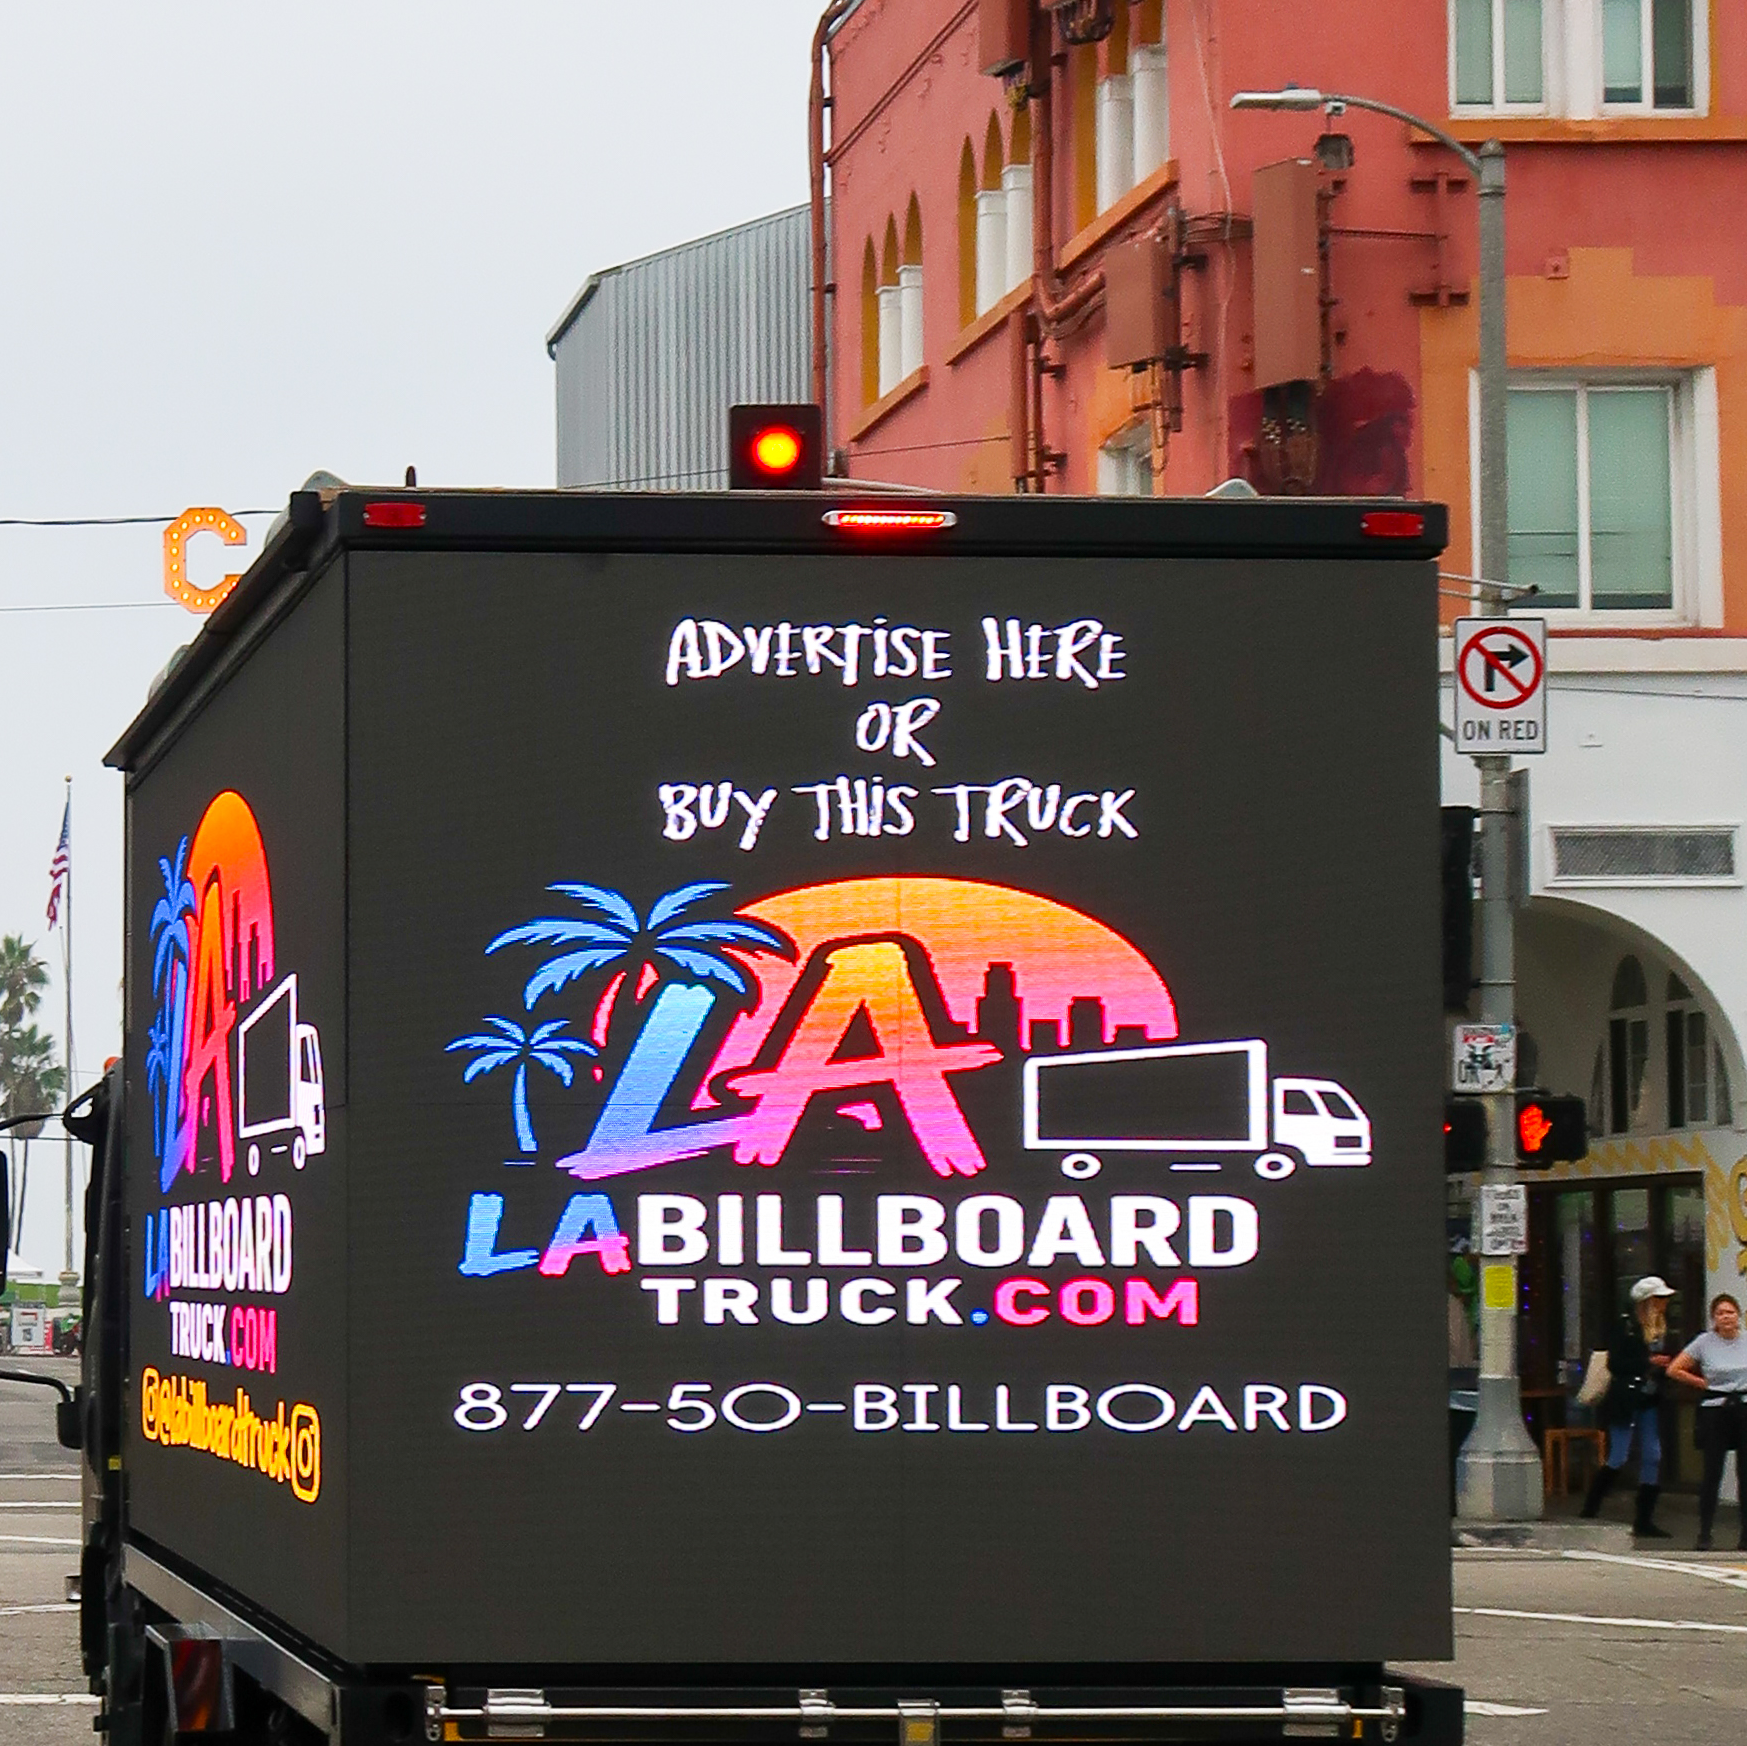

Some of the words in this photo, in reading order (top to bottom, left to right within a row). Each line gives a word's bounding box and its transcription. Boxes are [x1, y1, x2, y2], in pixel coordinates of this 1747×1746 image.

[666, 617, 953, 686] ADVERTISE
[982, 617, 1127, 689] HERE
[856, 697, 941, 767] OR
[1463, 720, 1491, 741] ON
[1499, 720, 1538, 741] RED
[658, 781, 778, 851] BUY
[791, 775, 920, 841] THIS
[931, 777, 1139, 847] TRUCK
[554, 939, 1004, 1180] LA
[169, 1301, 278, 1375] TRUCK.COM
[641, 1277, 1200, 1327] TRUCK.COM
